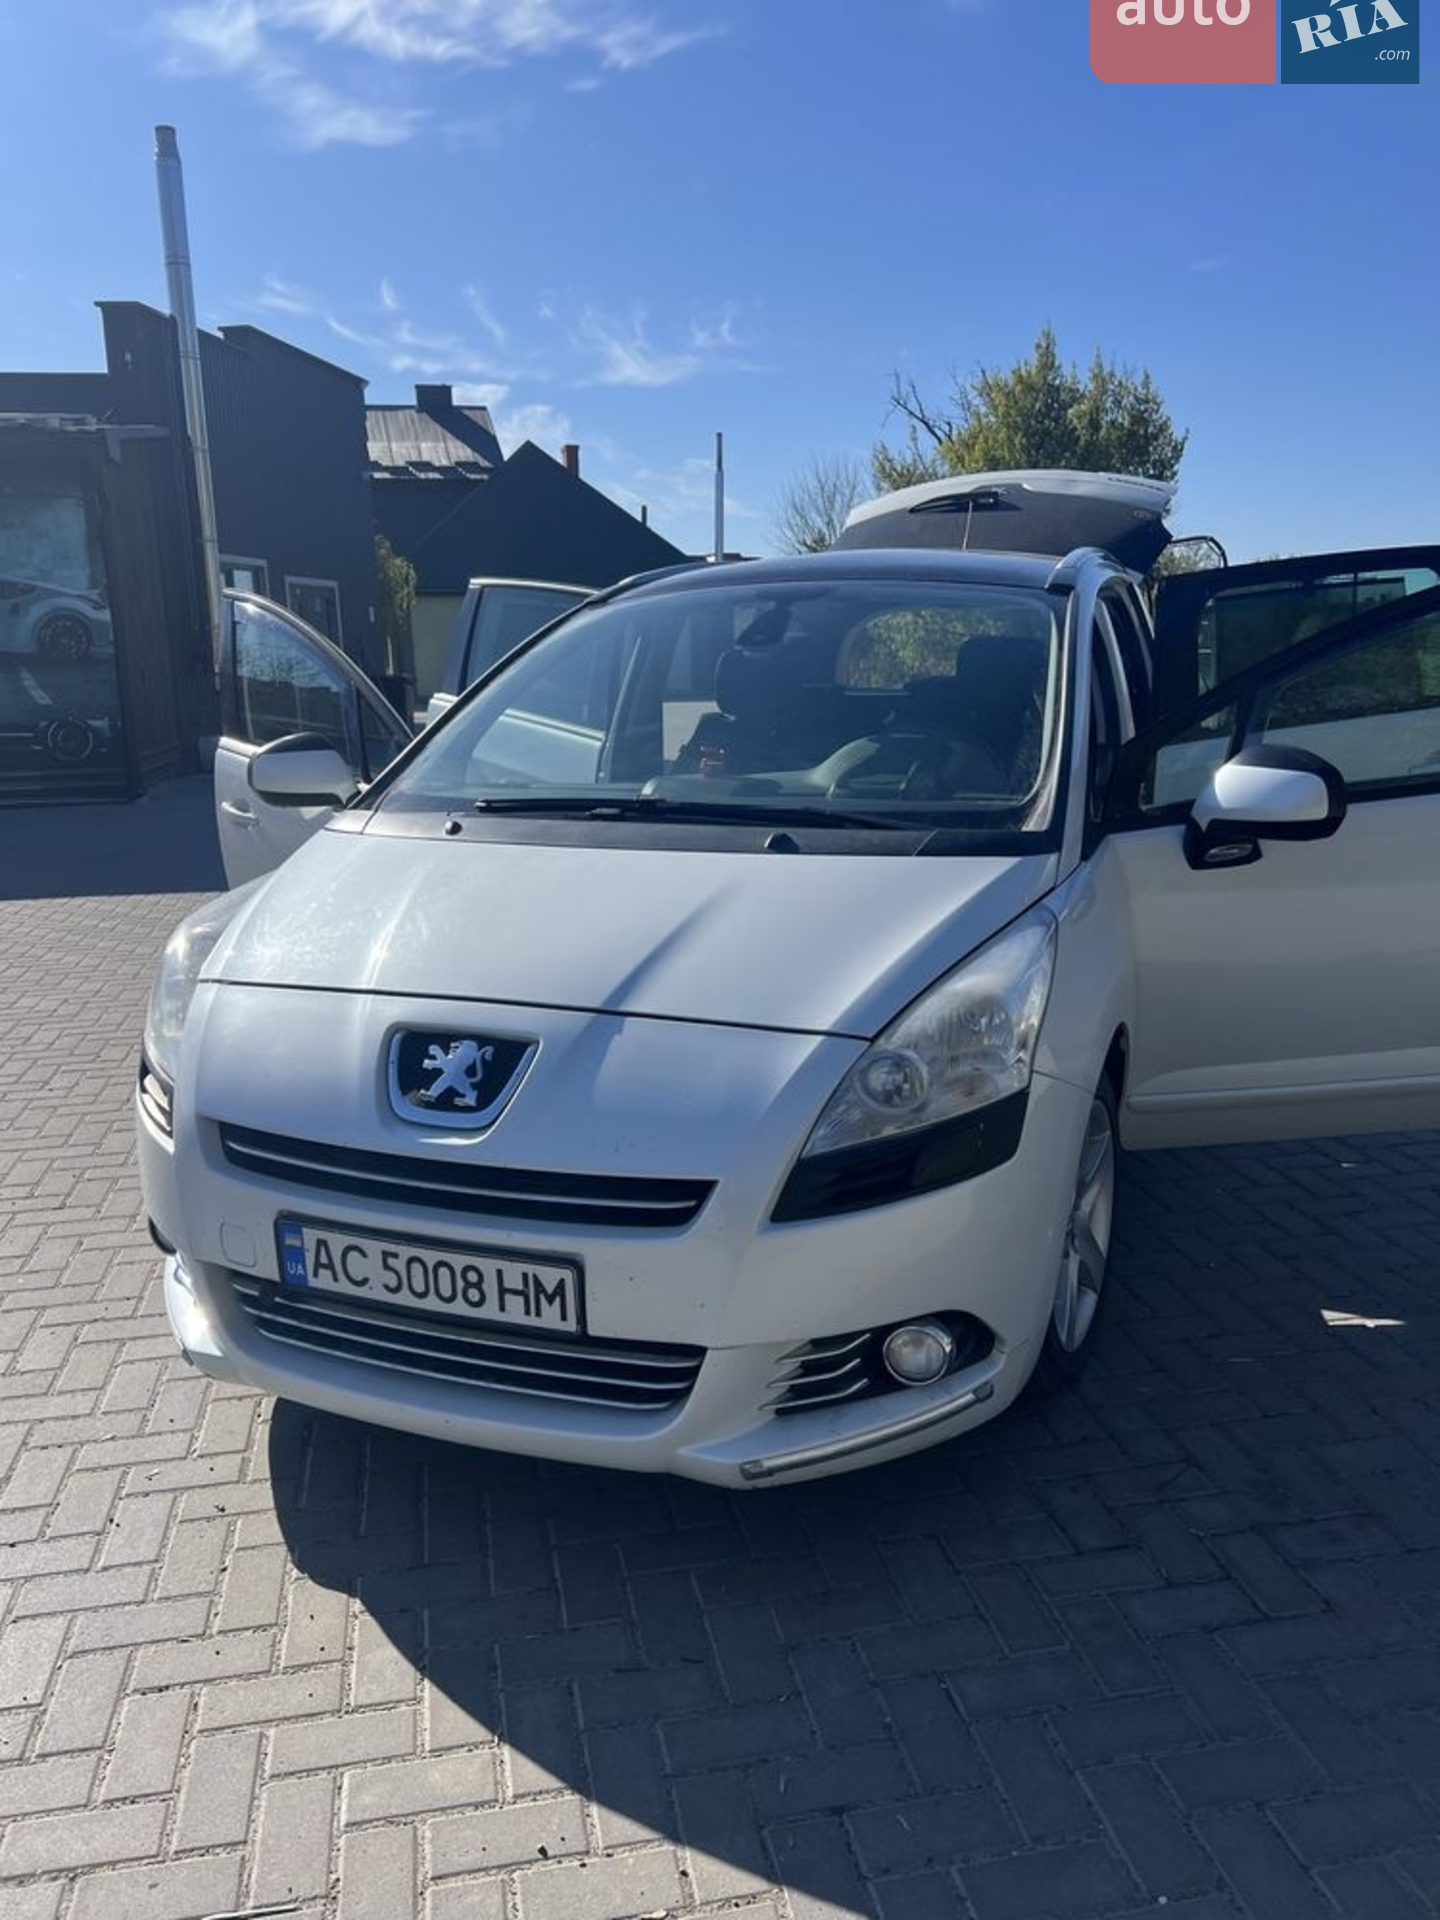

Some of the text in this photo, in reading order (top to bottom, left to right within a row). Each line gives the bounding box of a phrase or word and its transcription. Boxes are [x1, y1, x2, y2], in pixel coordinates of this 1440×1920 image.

[287, 1261, 305, 1277] UA
[312, 1238, 568, 1322] AC 5008 HM
